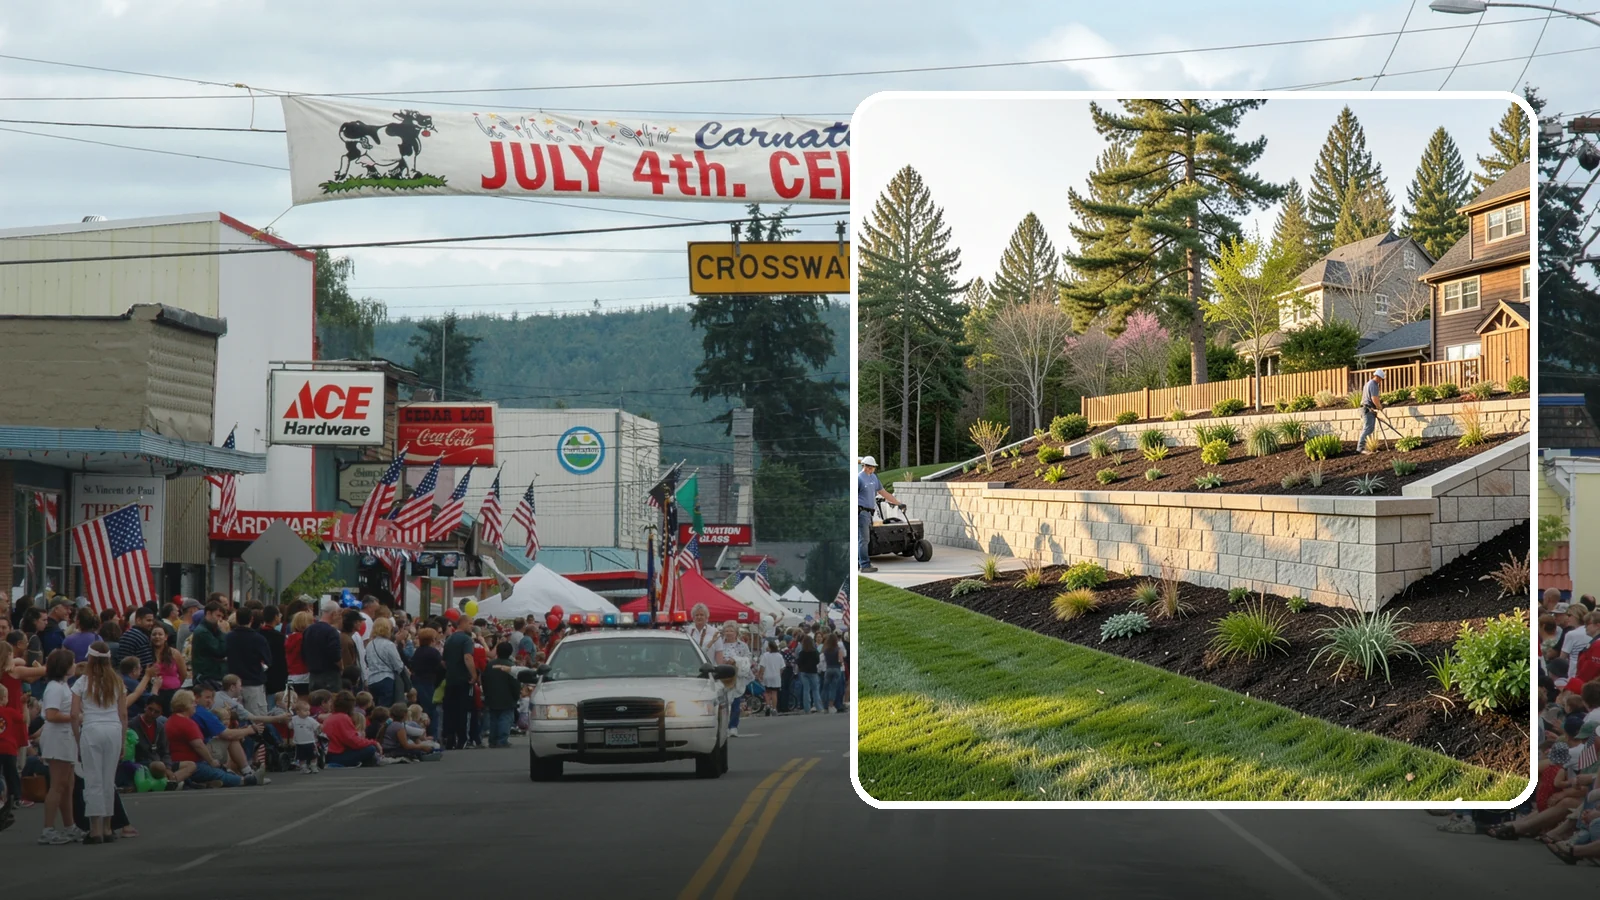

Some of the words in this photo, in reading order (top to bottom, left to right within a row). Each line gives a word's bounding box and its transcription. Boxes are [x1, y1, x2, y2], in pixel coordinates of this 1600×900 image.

[695, 121, 850, 150] Carnat
[481, 141, 605, 192] JULY
[632, 150, 746, 198] 4th.
[697, 254, 850, 280] CROSSWA
[282, 380, 374, 420] ACE
[406, 409, 452, 421] CEDAR
[283, 421, 371, 436] Hardware
[416, 428, 477, 447] Coca-Cola
[353, 467, 384, 480] Simpl
[96, 485, 124, 495] Vincent
[126, 486, 136, 495] de
[138, 486, 155, 495] Paul
[688, 527, 741, 535] CRNATION
[699, 535, 730, 543] GLASS
